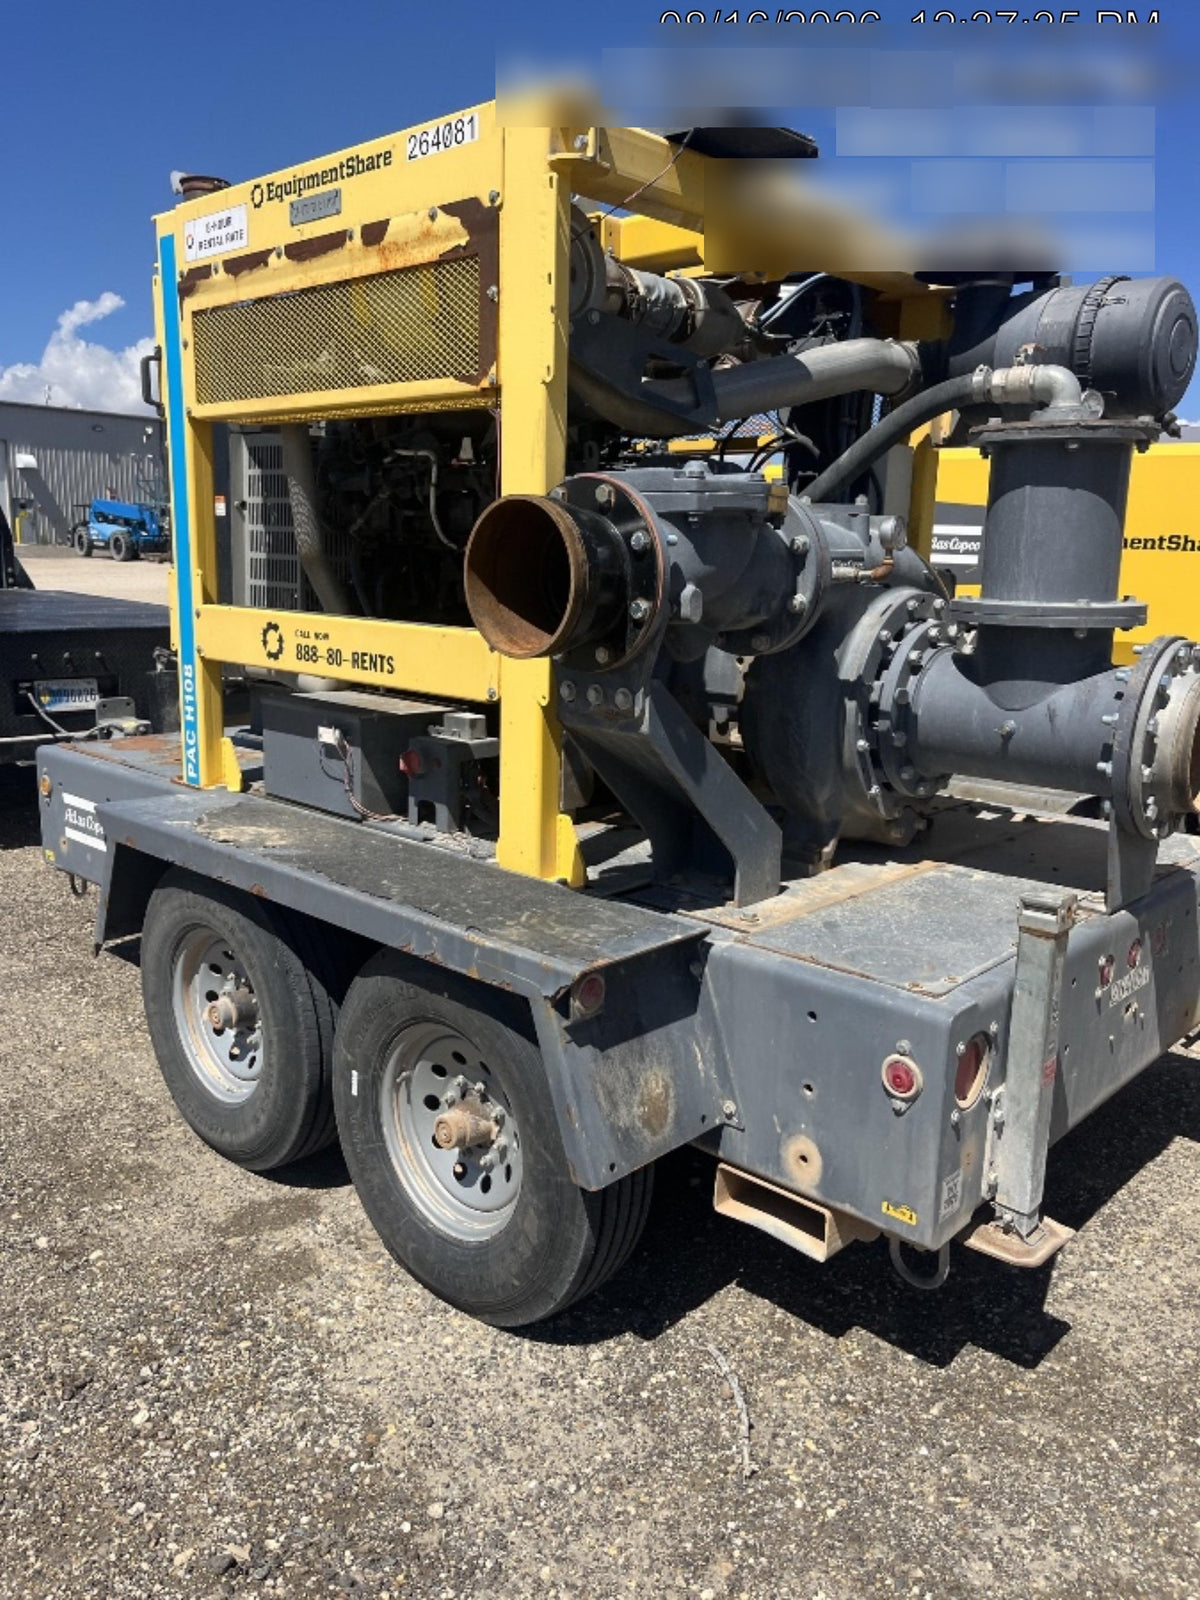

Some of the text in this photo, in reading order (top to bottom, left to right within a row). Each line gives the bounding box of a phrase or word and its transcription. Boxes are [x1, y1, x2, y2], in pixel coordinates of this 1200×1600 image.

[407, 114, 476, 161] 264081
[265, 148, 393, 203] EquipmentShare
[949, 536, 981, 554] Copco
[295, 628, 311, 639] CALL
[295, 642, 396, 675] 888-80-RENTS
[183, 663, 198, 779] PAC H108
